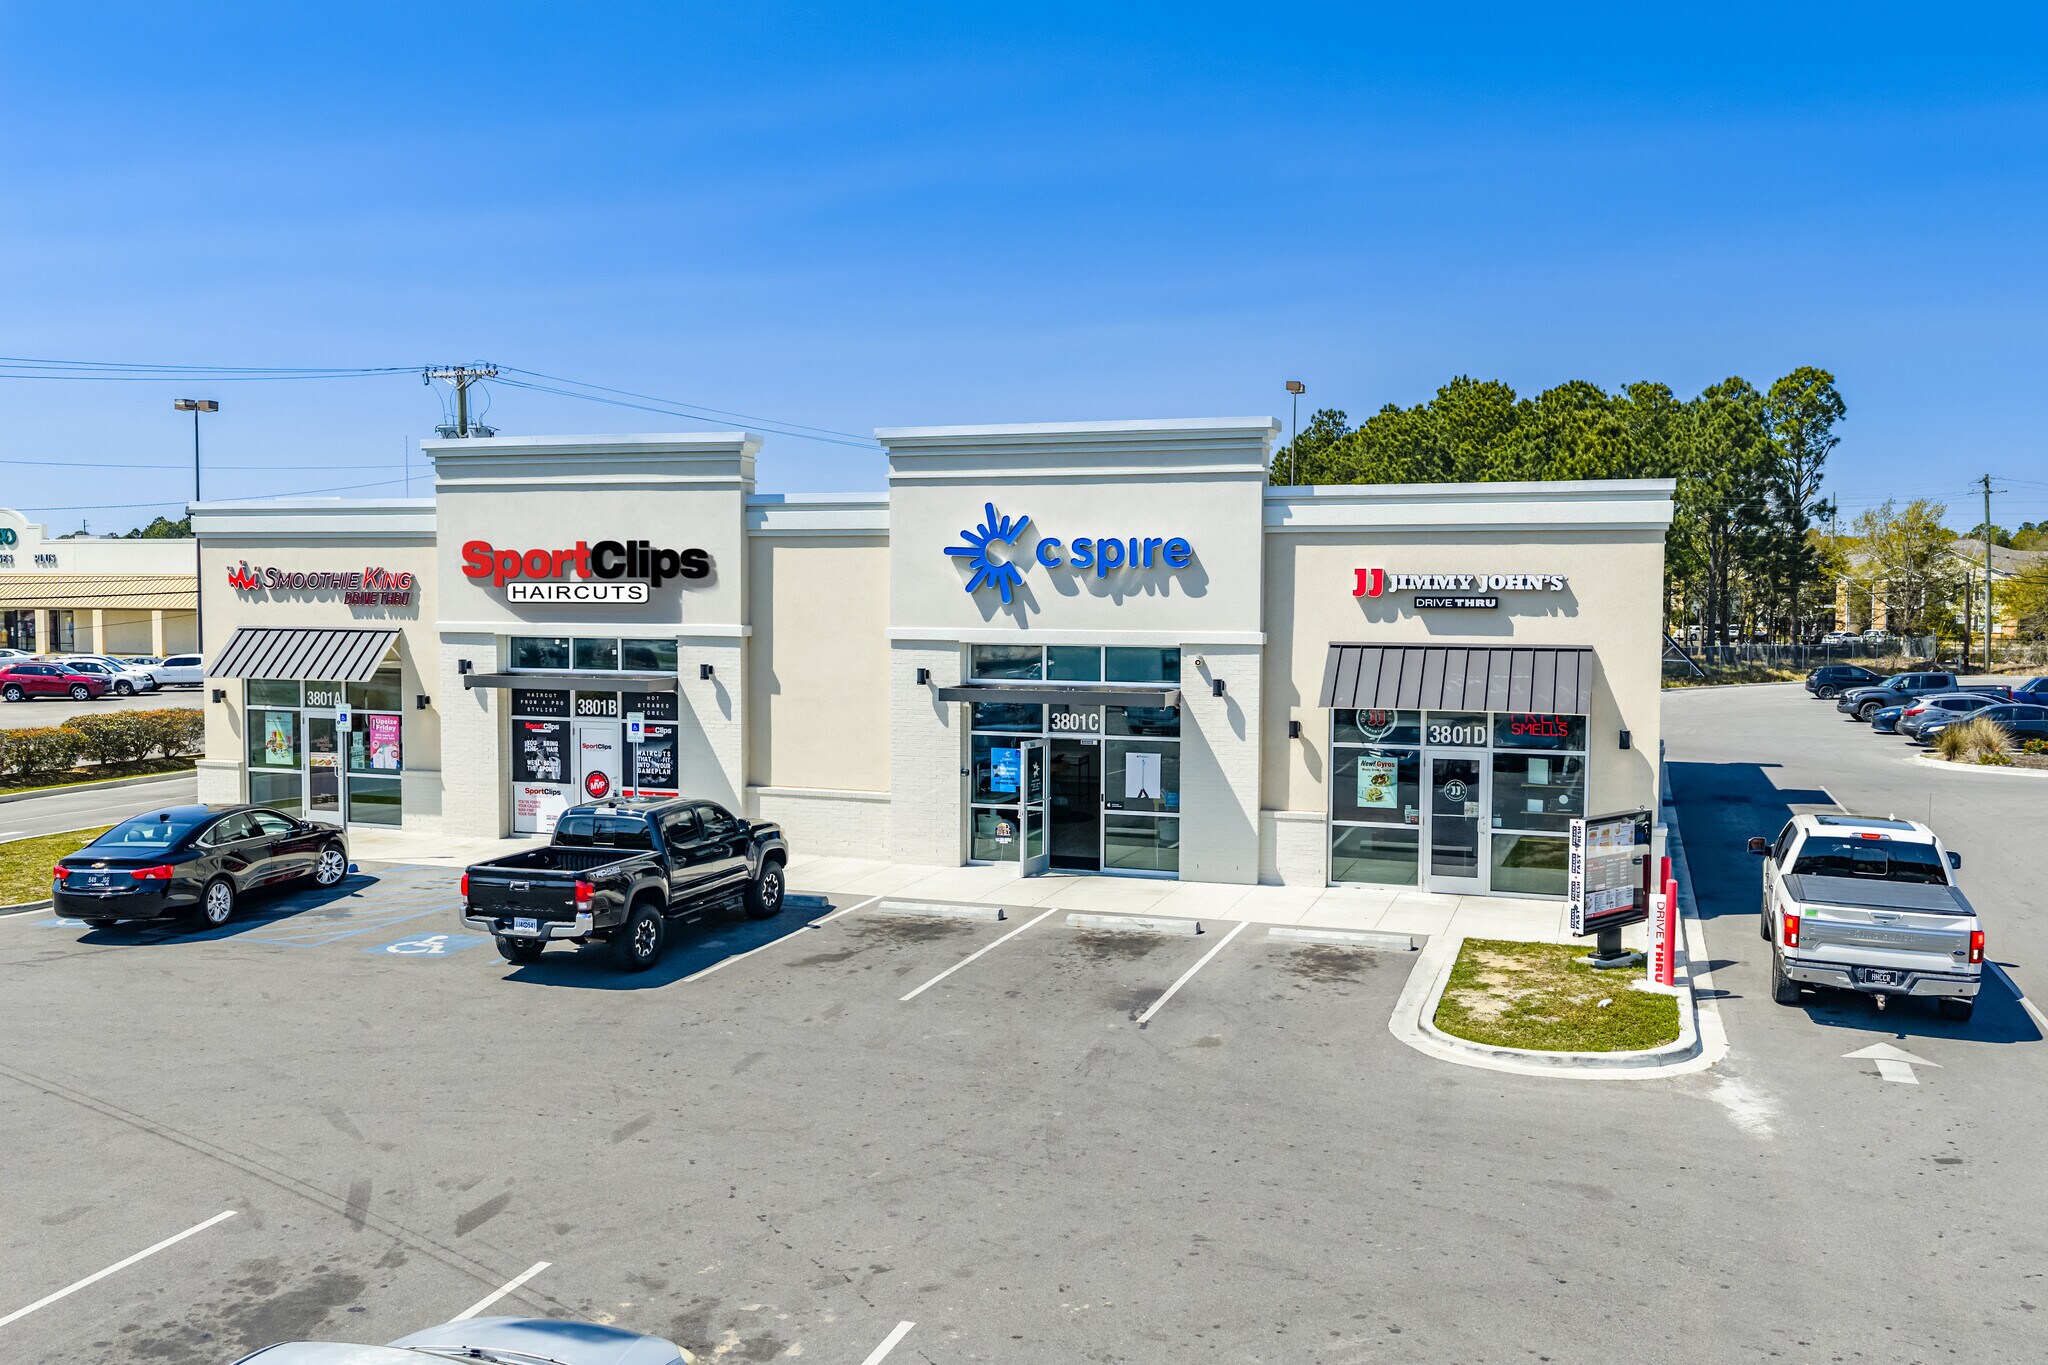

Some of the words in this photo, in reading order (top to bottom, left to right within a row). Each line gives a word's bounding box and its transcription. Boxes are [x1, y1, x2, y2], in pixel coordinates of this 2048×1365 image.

[34, 554, 57, 563] PLUS
[461, 540, 711, 588] SportClips
[1070, 537, 1192, 579] spire
[263, 567, 360, 590] SMOOTHIE
[1352, 568, 1384, 598] JJ
[1388, 574, 1474, 594] JIMMY
[1478, 574, 1565, 594] JOHN'S
[343, 591, 377, 606] DRIVE
[379, 592, 410, 606] THRU
[512, 585, 643, 600] HAIRCUTS
[1416, 598, 1453, 608] DRIVE
[1454, 598, 1496, 608] THRU
[306, 691, 342, 706] 3801A
[577, 699, 617, 715] 3801B
[525, 722, 560, 731] SportClips
[1051, 712, 1099, 731] 3801C
[1429, 725, 1486, 745] 3801D
[1511, 723, 1569, 737] SMELLS
[525, 787, 562, 796] SportClips
[590, 781, 605, 790] MVP
[1655, 901, 1666, 939] DRIVE
[1654, 942, 1664, 984] THRU
